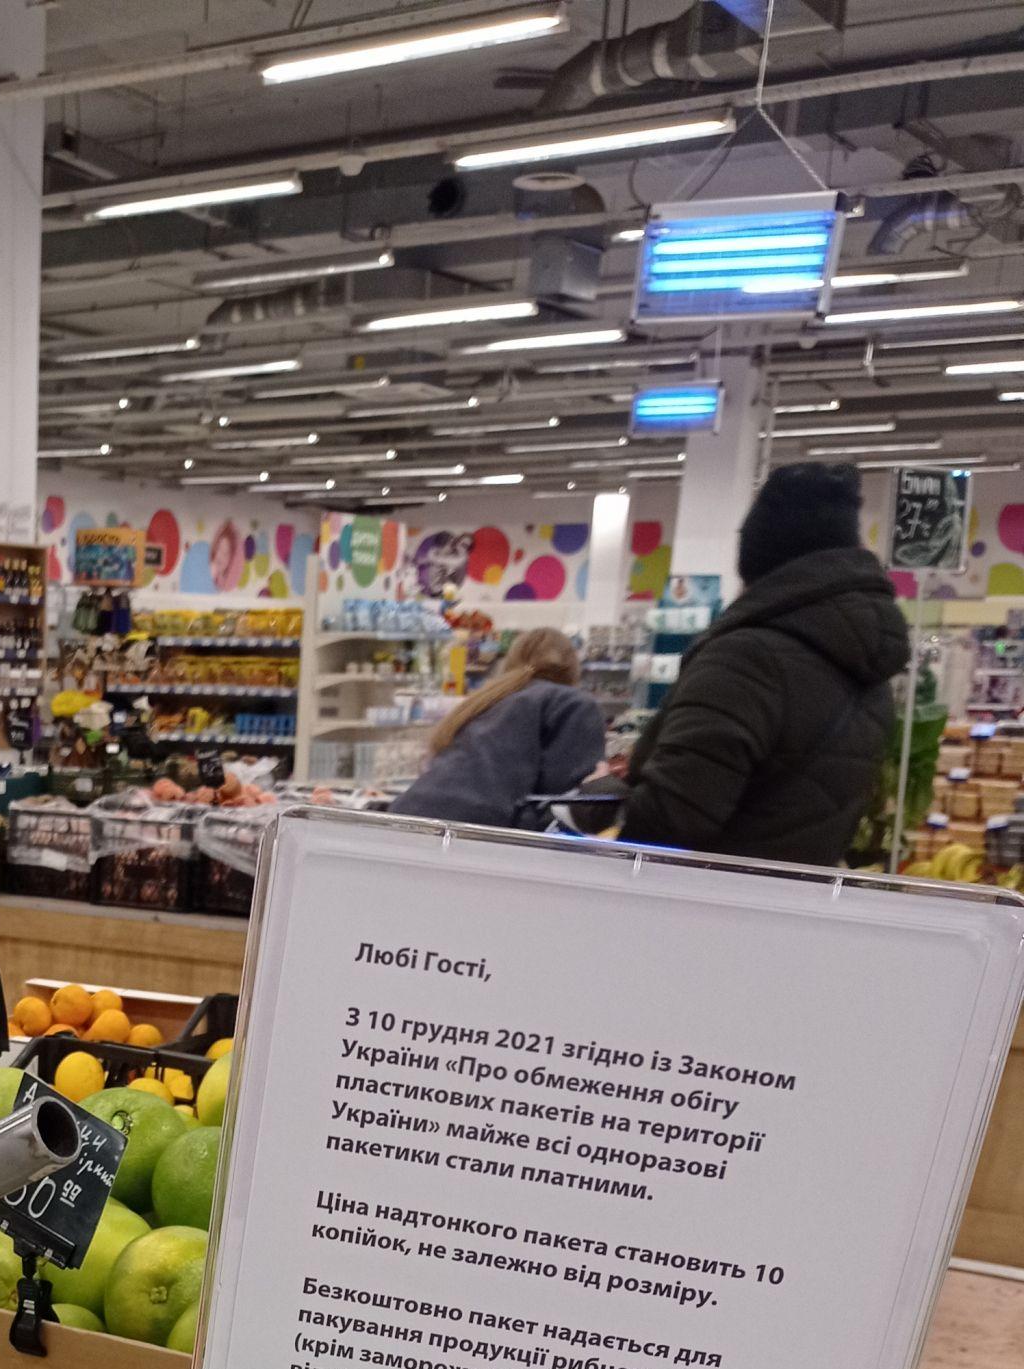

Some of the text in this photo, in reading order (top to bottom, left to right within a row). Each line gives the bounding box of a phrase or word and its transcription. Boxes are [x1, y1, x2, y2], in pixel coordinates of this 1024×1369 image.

[354, 942, 492, 983] Любі Гості,
[340, 1037, 740, 1121] України «Про обмеження обігу
[344, 1006, 797, 1091] З 10 грудня 2021 згідно із Законом
[331, 1099, 728, 1181] України» майже всі одноразові
[335, 1073, 767, 1154] пластикових пакетів на території
[325, 1135, 654, 1201] пакетики стали платними.
[311, 1223, 718, 1309] копійок, не залежно від розміру.
[316, 1189, 785, 1286] Ціна надтонкого пакета становить 10
[294, 1332, 355, 1360] (крім
[297, 1308, 424, 1344] пакування
[428, 1332, 551, 1368] продукції
[302, 1276, 723, 1369] Безкоштовно пакет надається для
